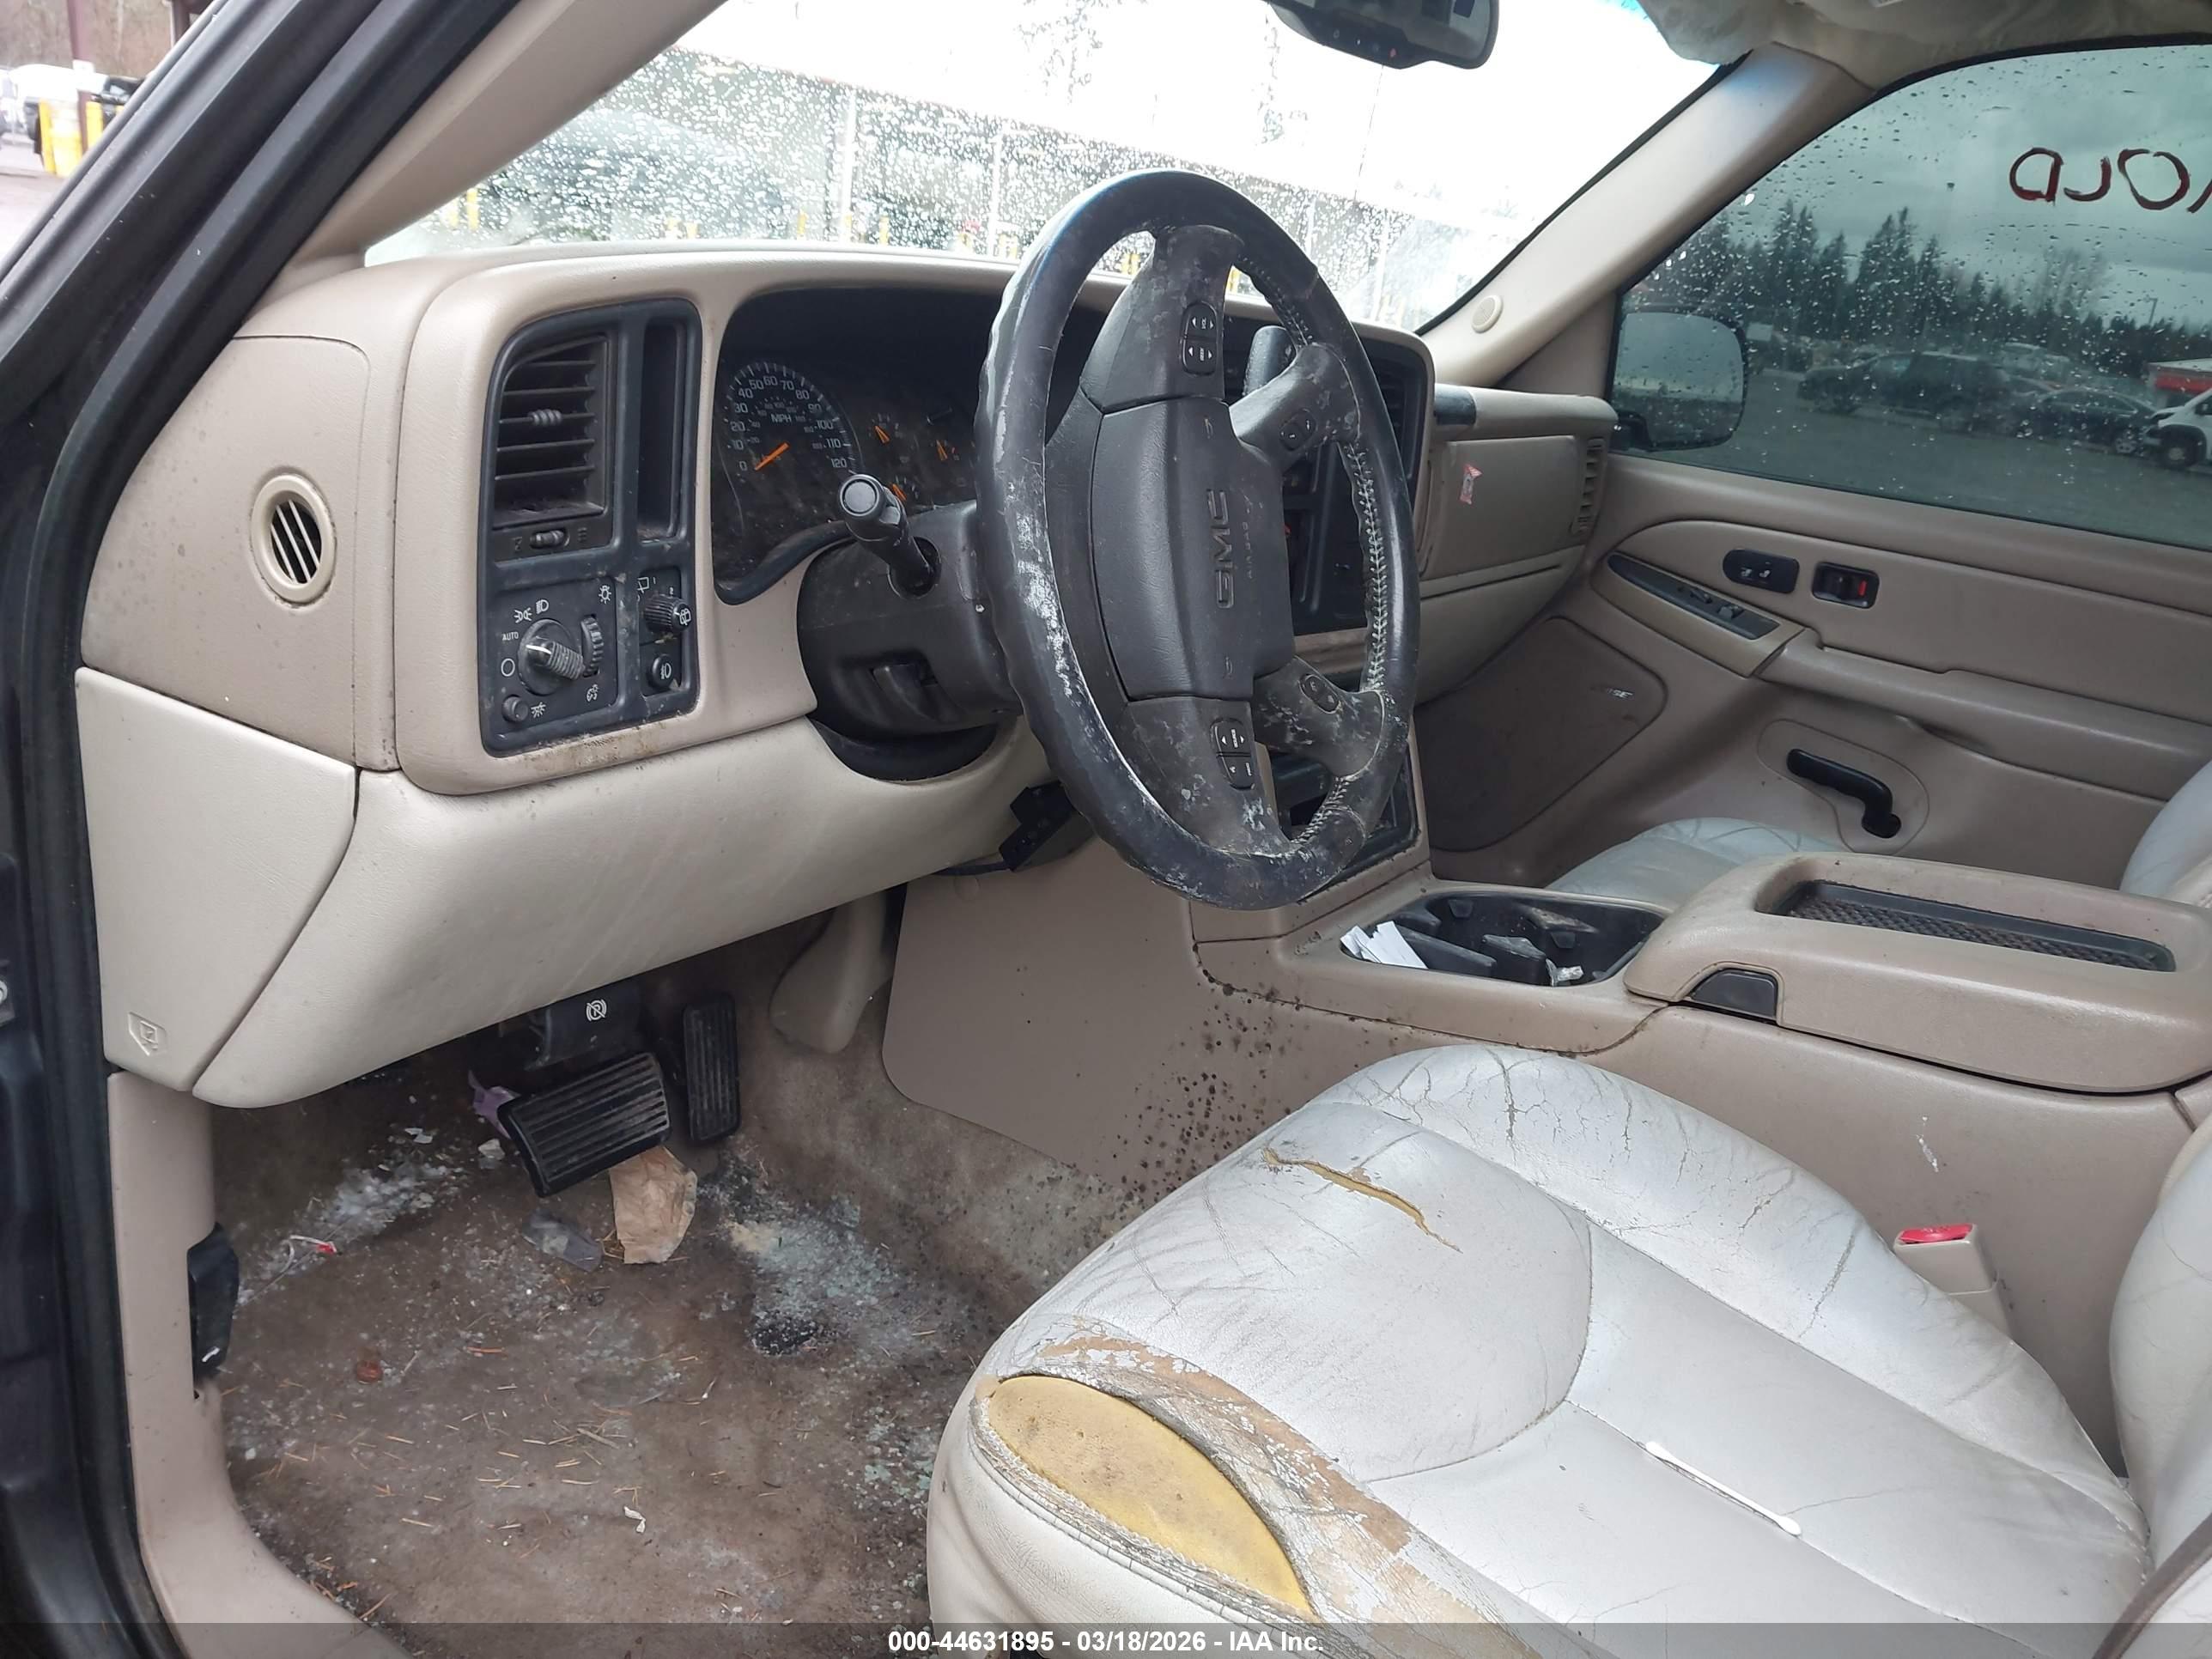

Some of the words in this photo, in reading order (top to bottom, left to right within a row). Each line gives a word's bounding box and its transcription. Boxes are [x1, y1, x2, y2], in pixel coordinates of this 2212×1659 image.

[749, 380, 764, 390] 50
[763, 376, 778, 386] 60
[780, 380, 794, 391] 70
[738, 388, 753, 398] 40
[795, 390, 810, 399] 80
[734, 403, 748, 413] 30
[808, 404, 821, 413] 90
[771, 413, 792, 423] MPH
[731, 422, 745, 432] 20
[817, 420, 834, 429] 100
[732, 440, 744, 450] 10
[827, 439, 841, 448] 110
[738, 460, 748, 471] 0
[830, 459, 847, 468] 120
[1206, 489, 1235, 609] GMC
[501, 631, 519, 641] AUTO
